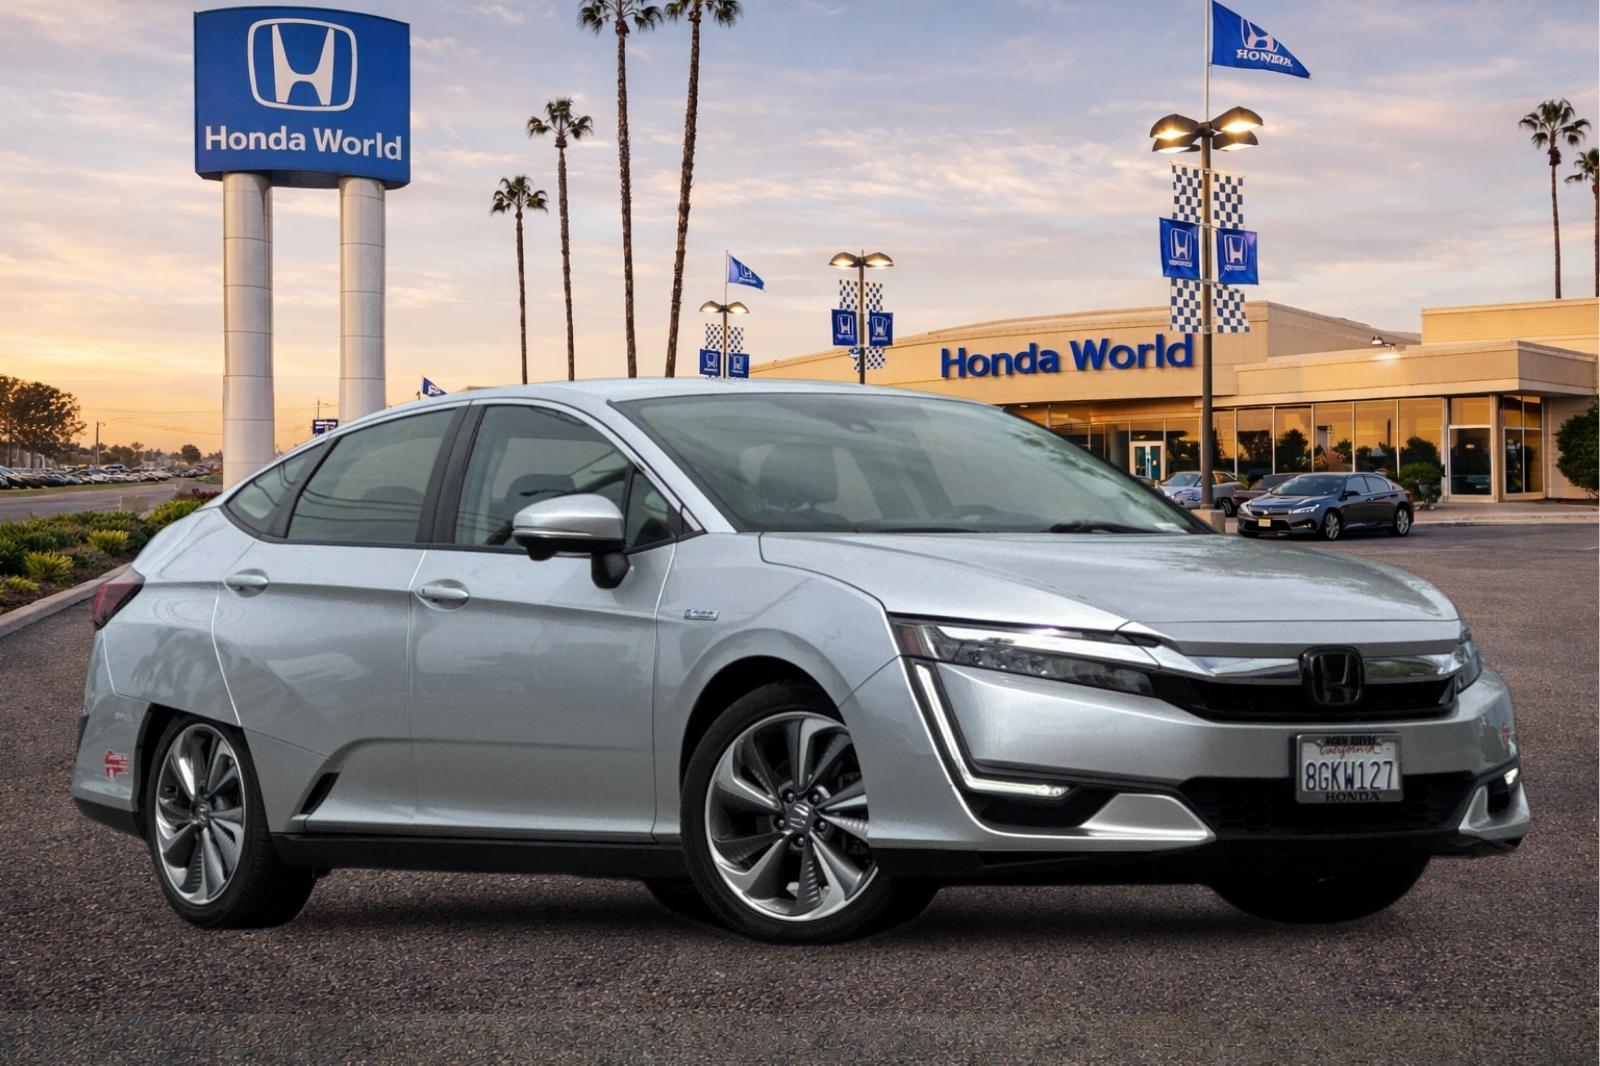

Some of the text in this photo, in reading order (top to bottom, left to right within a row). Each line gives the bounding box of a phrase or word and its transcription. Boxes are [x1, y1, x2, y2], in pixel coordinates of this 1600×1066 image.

[205, 125, 402, 161] Honda World
[941, 333, 1194, 378] Honda World
[1319, 745, 1376, 759] California
[1305, 760, 1393, 791] 8GKW127
[1325, 791, 1381, 801] HONDA
